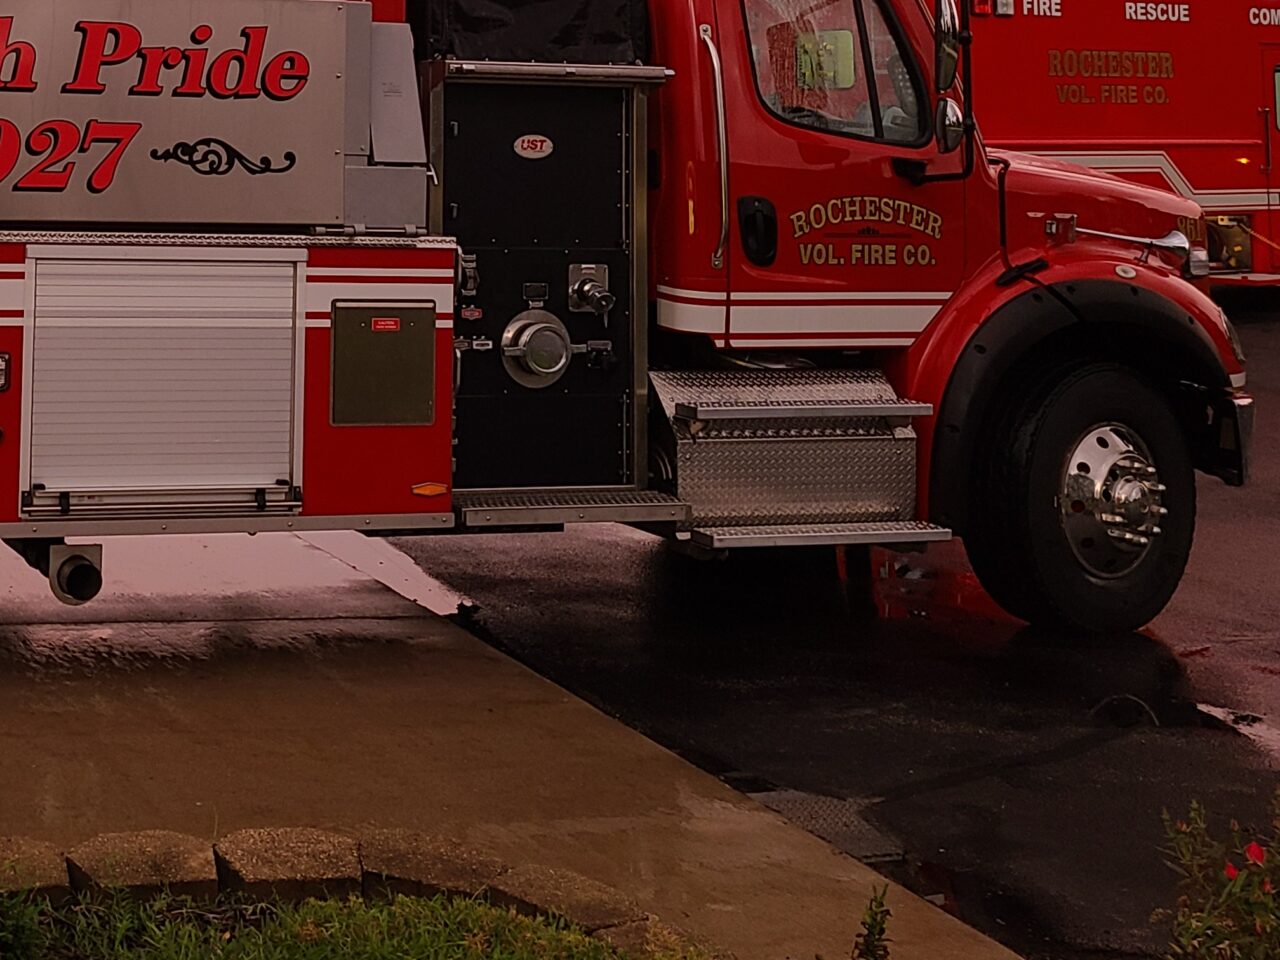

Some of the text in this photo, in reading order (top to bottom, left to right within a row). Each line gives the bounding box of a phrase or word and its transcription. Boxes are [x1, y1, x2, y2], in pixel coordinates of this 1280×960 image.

[1125, 2, 1190, 22] RESCUE
[1249, 7, 1280, 26] COM
[60, 20, 310, 101] Pride
[1047, 49, 1175, 78] ROCHESTER
[1056, 84, 1170, 104] VOL. FIRE CO.
[521, 139, 547, 151] UST
[790, 196, 943, 239] ROCHESTER
[799, 243, 936, 265] VOL. FIRE CO.
